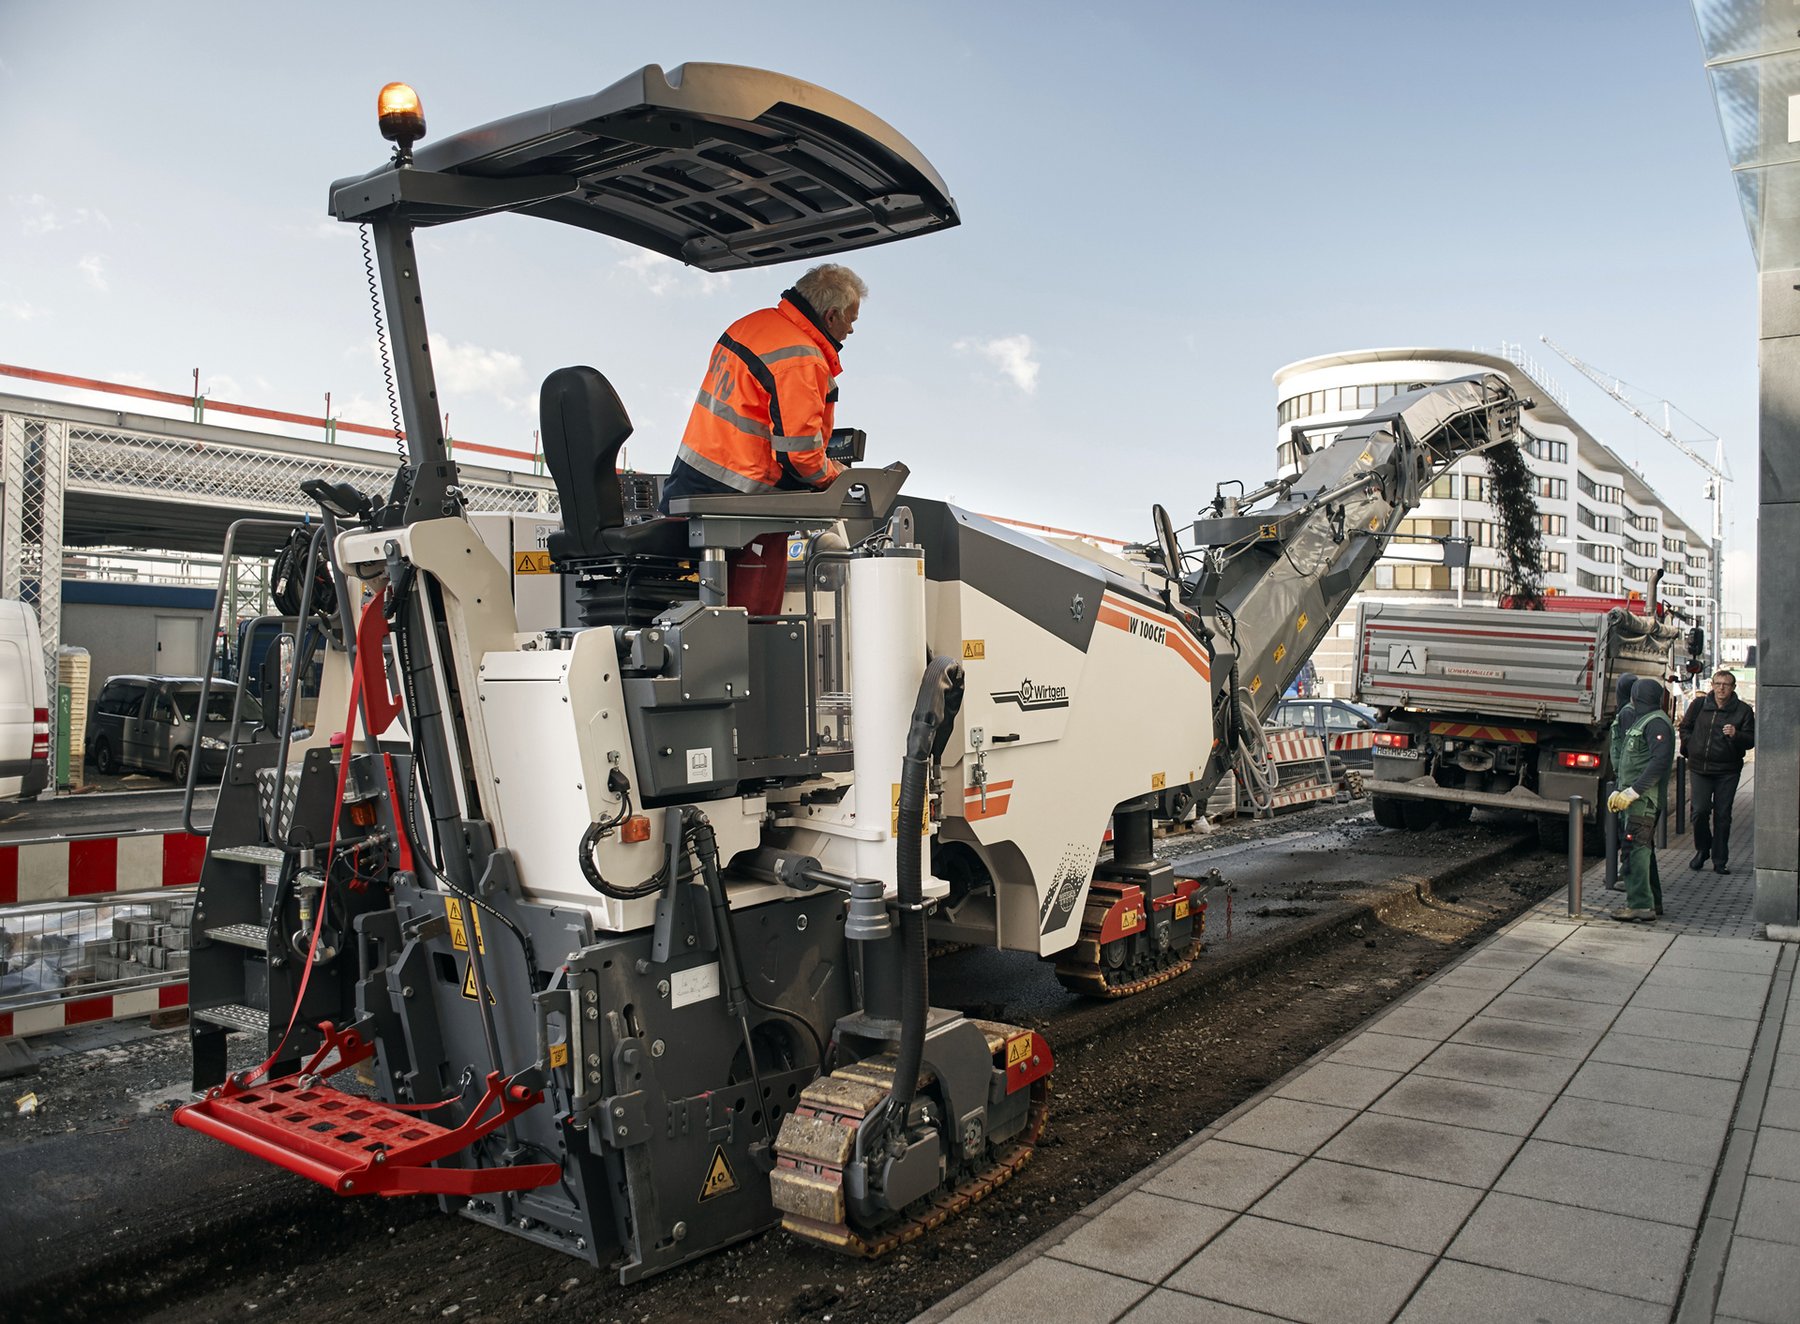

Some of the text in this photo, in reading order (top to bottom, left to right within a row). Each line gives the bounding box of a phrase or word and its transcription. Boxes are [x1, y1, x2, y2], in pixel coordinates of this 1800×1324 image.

[1130, 616, 1139, 635] W
[1396, 648, 1417, 670] A
[1034, 685, 1066, 701] Wirtgen
